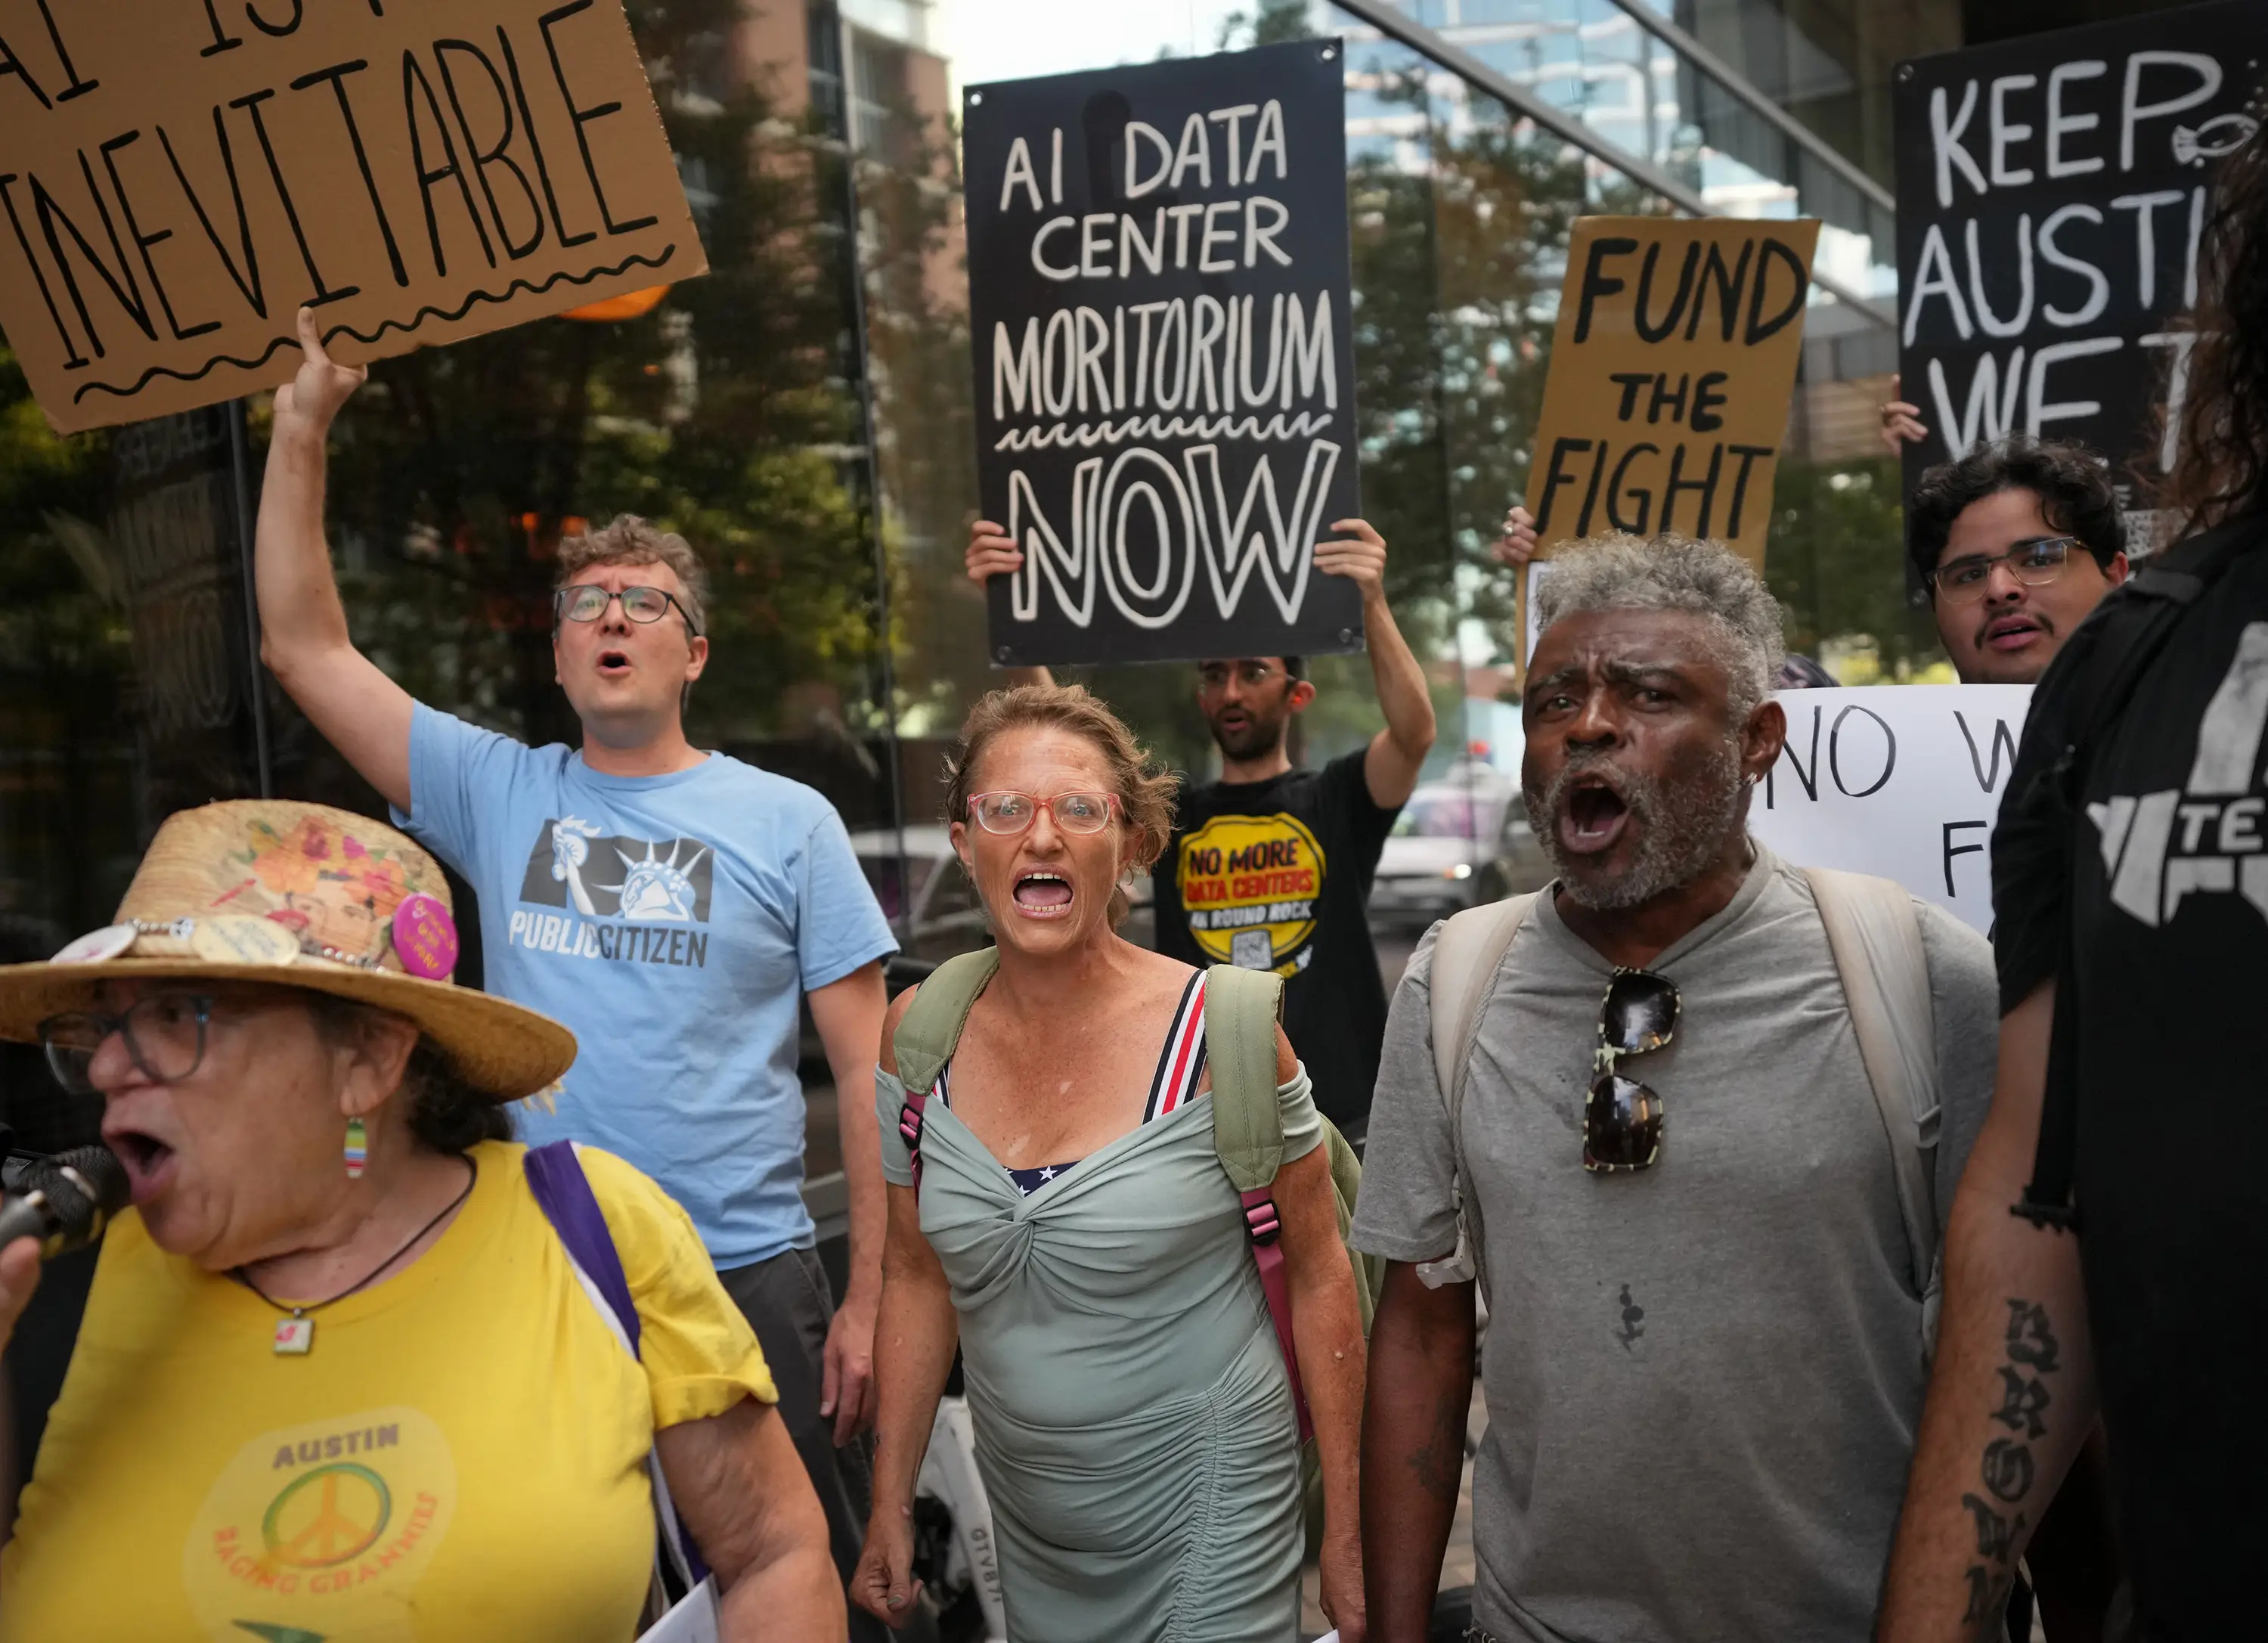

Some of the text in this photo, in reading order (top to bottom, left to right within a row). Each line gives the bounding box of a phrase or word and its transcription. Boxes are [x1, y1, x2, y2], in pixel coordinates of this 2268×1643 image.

[1000, 99, 1287, 212] AI DATA
[1930, 51, 2223, 208] KEEP
[0, 0, 658, 369] INEVITABLE
[1031, 197, 1293, 280] CENTER
[1904, 185, 2208, 347] AUSTI
[1573, 238, 1808, 346] FUND
[993, 290, 1338, 421] MORITORIUM
[1610, 371, 1729, 432] THE
[1009, 439, 1341, 628] NOW
[1535, 436, 1774, 539] FIGHT
[1766, 705, 1896, 810] NO
[1186, 870, 1314, 902] DATA CENTERS
[1190, 839, 1300, 876] NO MORE
[509, 910, 599, 959] PUBLIC
[597, 923, 708, 969] CITIZEN
[1210, 905, 1267, 928] ROUND
[1269, 901, 1312, 920] ROCK
[273, 1424, 400, 1469] AUSTIN
[309, 1490, 438, 1595] GRANNIES
